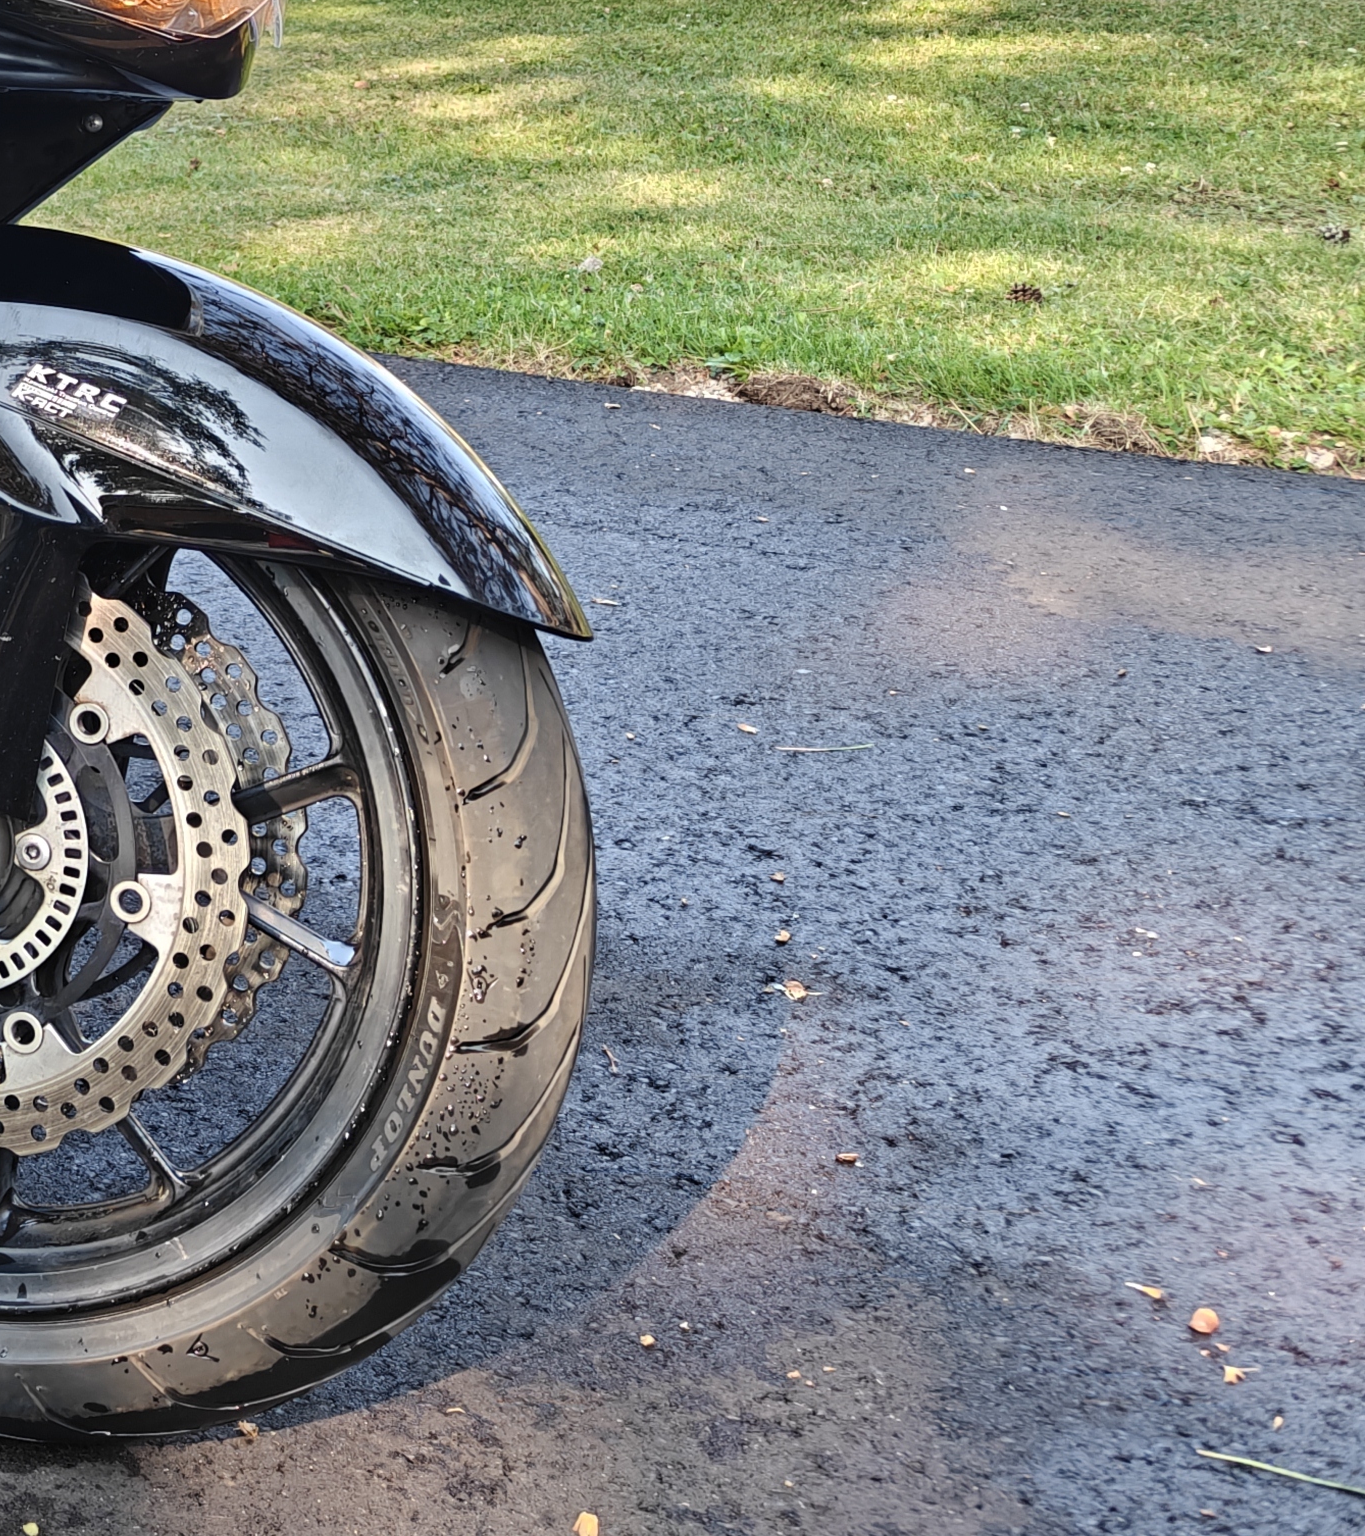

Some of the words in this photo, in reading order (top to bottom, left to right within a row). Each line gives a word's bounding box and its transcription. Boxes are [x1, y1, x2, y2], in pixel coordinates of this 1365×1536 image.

[11, 387, 73, 418] K-ACT
[26, 363, 127, 414] KTRC
[369, 996, 445, 1173] DUNLOP
